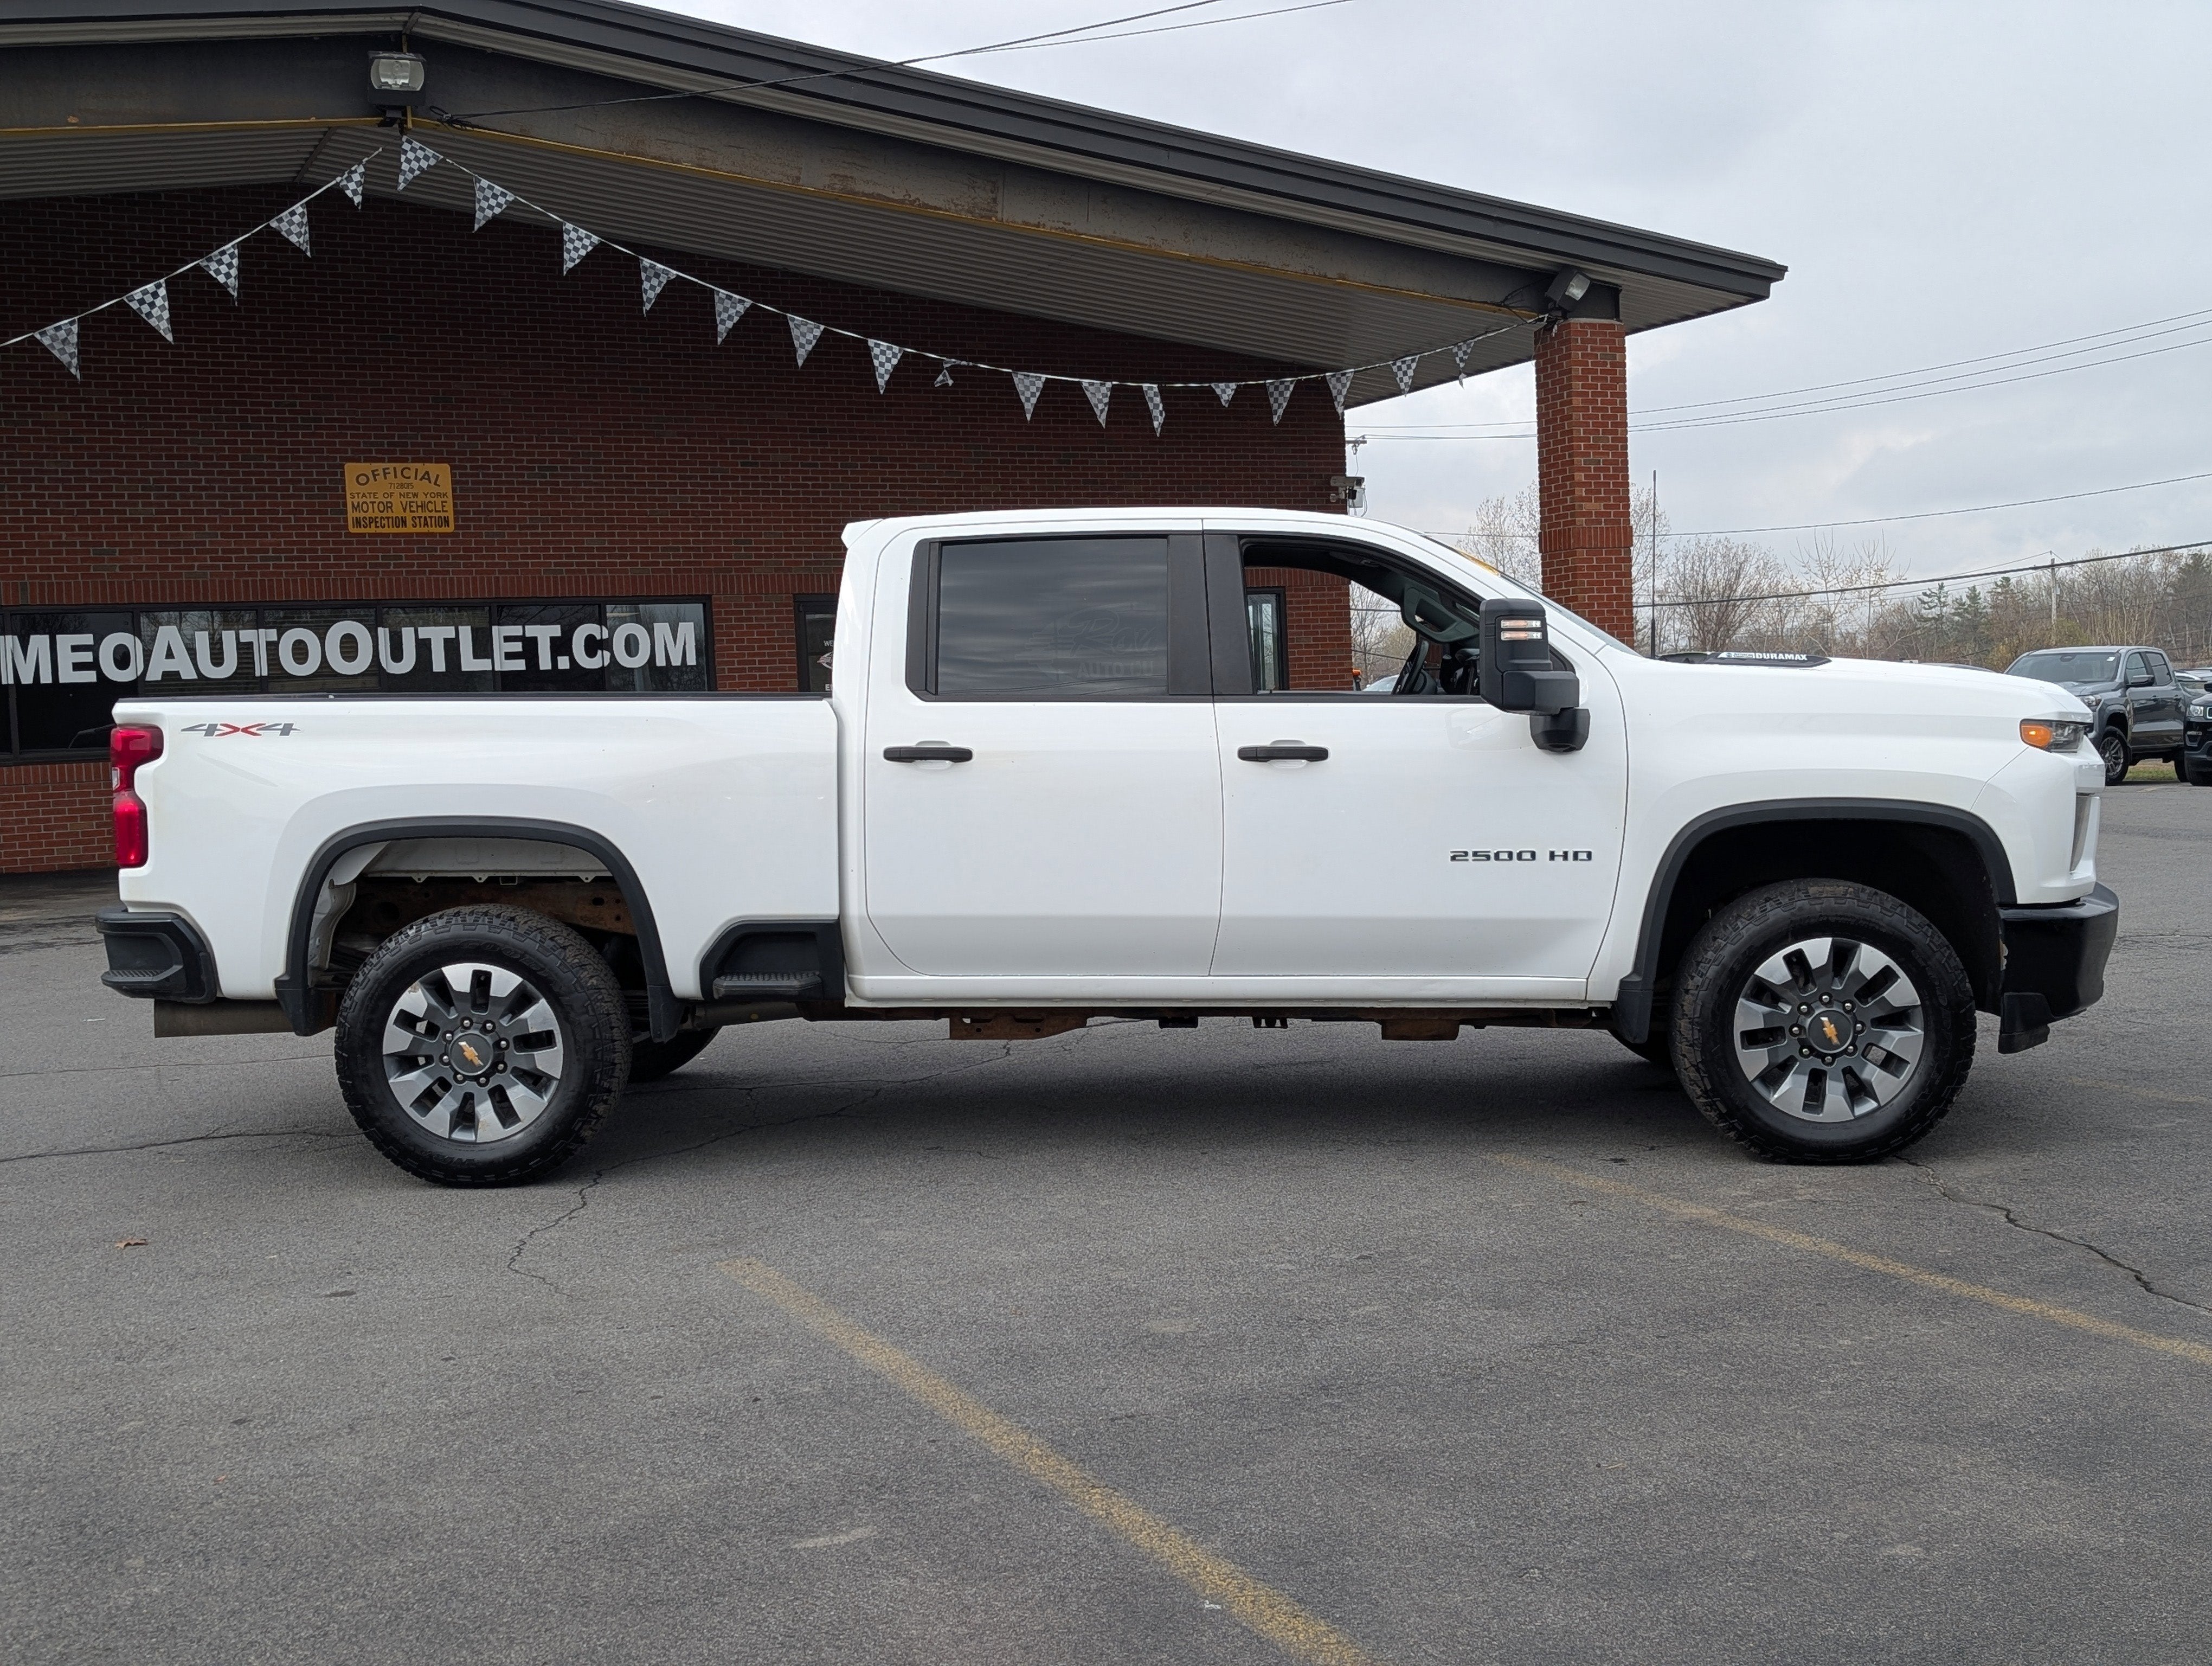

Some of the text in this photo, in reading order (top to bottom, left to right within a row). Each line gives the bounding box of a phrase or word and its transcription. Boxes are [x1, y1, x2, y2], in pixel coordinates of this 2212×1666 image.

[355, 466, 441, 487] OFFICIAL
[351, 501, 448, 513] MOTOR VEHICLE
[352, 516, 450, 529] INSPECTION STATION
[1756, 652, 1808, 661] DURAMAX
[1450, 850, 1593, 862] 2500 HD
